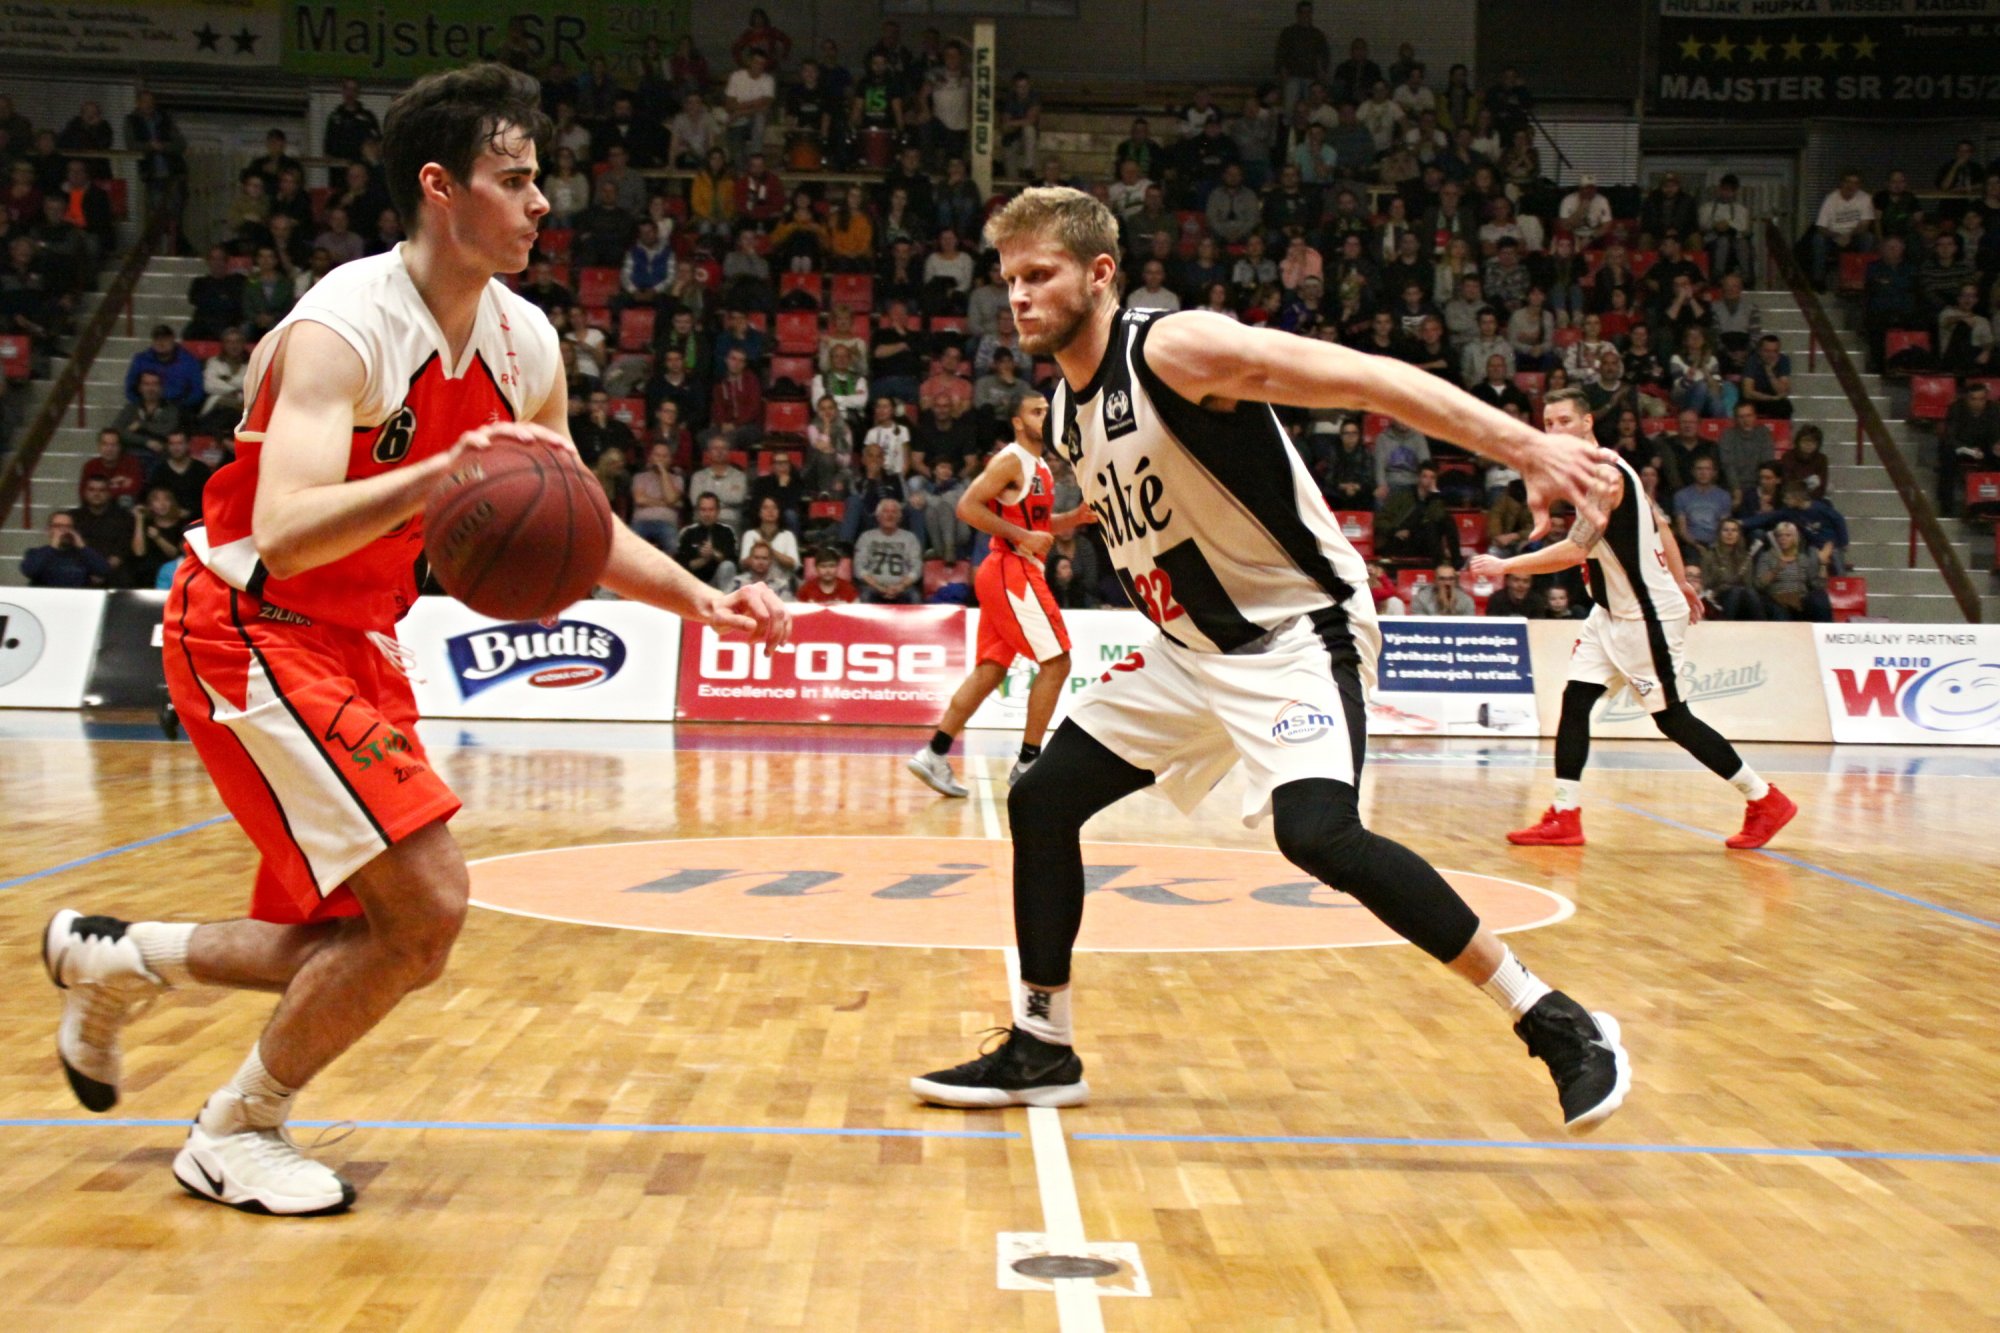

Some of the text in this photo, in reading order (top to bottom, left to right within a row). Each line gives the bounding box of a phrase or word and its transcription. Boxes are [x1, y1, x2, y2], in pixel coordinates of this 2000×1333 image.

[296, 4, 589, 69] Majster SR
[1660, 75, 1825, 101] MAJSTER
[1836, 75, 1881, 100] SR
[372, 406, 417, 463] 6
[872, 552, 903, 576] 76
[1455, 635, 1519, 648] predajca
[1825, 632, 1977, 645] MEDIÁLNY PARTNER
[462, 626, 613, 680] Budiš
[699, 625, 948, 683] brose
[1874, 656, 1931, 668] RADIO
[697, 683, 950, 702] Excellence in Mechatronics
[1272, 714, 1335, 738] msm
